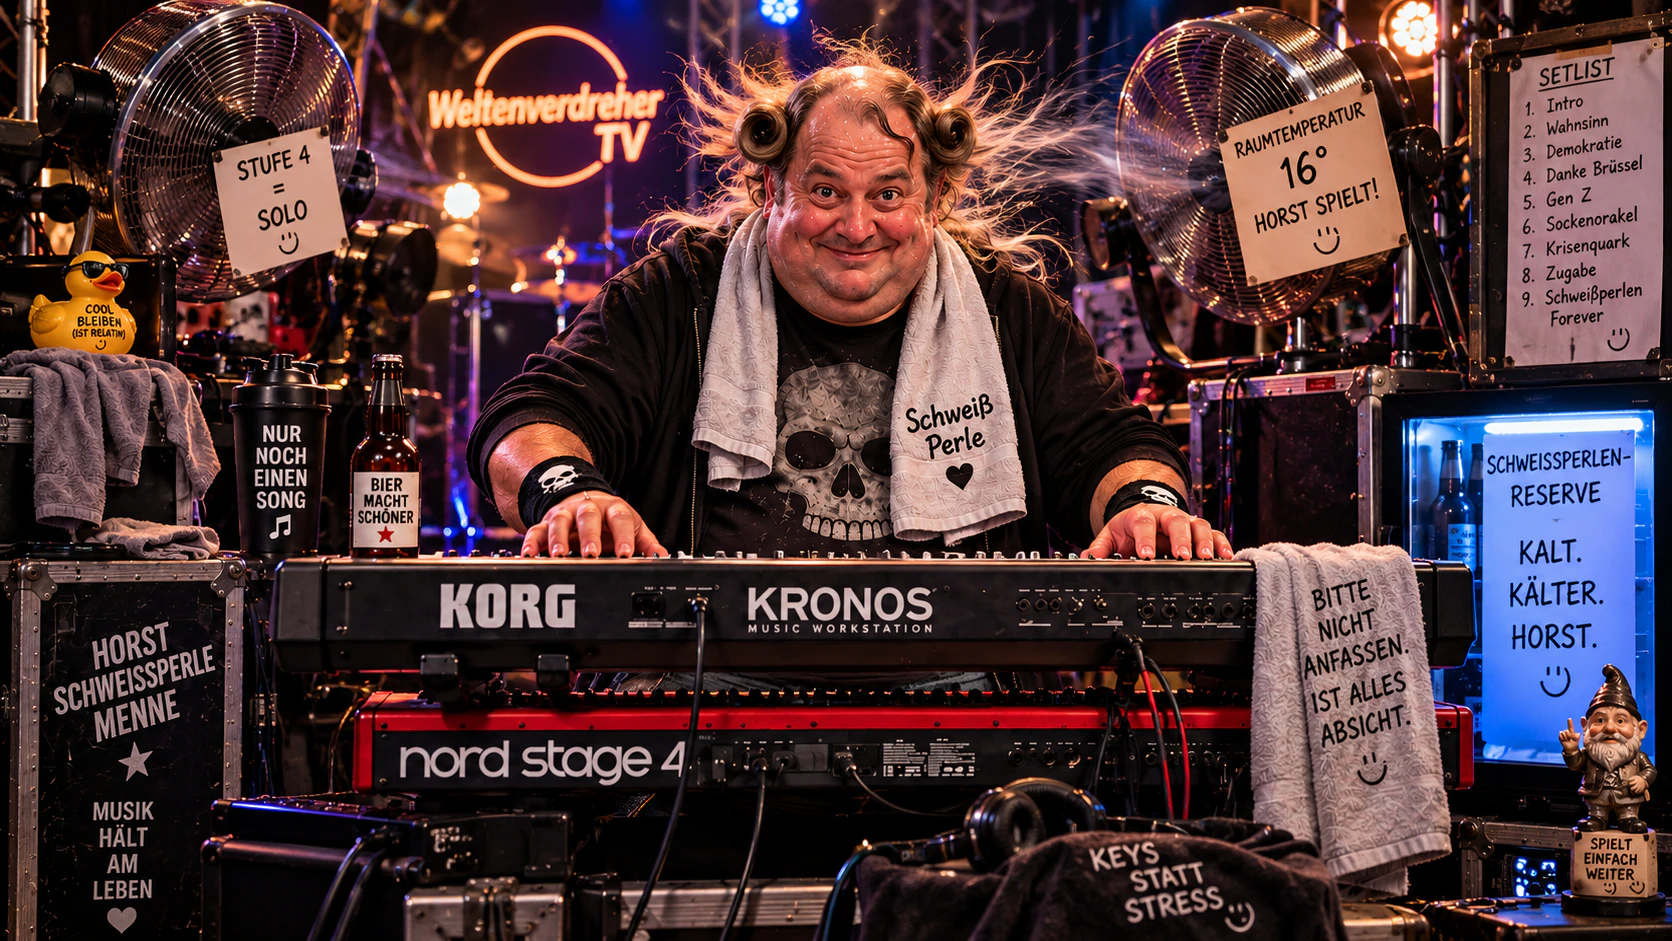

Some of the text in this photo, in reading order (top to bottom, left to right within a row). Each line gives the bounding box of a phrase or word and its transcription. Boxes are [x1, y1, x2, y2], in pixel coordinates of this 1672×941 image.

[1539, 56, 1616, 87] SETLIST
[428, 81, 665, 130] Weltenverdreher
[1525, 96, 1584, 117] 1. Intro
[1234, 101, 1365, 159] RAUMTEMPERATUR
[1523, 116, 1609, 139] 2. Wahnsinn
[593, 120, 651, 163] TV
[1523, 136, 1622, 163] 3. Demokratie
[237, 145, 310, 181] STUFE 4
[1280, 145, 1327, 189] 16°
[1523, 154, 1643, 186] 4. Danke Brüssel
[273, 183, 285, 194] =
[1523, 187, 1592, 210] 5. Gen Z
[258, 200, 307, 231] SOLO
[1254, 177, 1379, 234] HORST SPIELT!
[1522, 205, 1638, 235] 6. Sockenorakel
[1522, 232, 1630, 259] 7. Krisenquark
[1522, 262, 1597, 284] 8. Zugabe
[1521, 281, 1643, 308] 9. Schweißperlen
[77, 316, 122, 327] BLEIBEN
[85, 304, 114, 315] COOL
[1551, 310, 1605, 327] Forever
[72, 329, 89, 339] (IST
[906, 393, 994, 433] Schweiß
[262, 425, 302, 443] NUR
[925, 426, 986, 460] Perle
[256, 447, 307, 465] NOCH
[1487, 447, 1631, 475] SCHWEISSPERLEN-
[254, 469, 308, 487] EINEN
[371, 477, 403, 492] BIER
[256, 491, 306, 510] SONG
[363, 494, 409, 508] MACHT
[1511, 481, 1601, 508] RESERVE
[357, 508, 414, 524] SCHÖNER
[1519, 539, 1582, 565] KALT.
[748, 586, 933, 621] KRONOS
[1311, 578, 1371, 612] BITTE
[1510, 576, 1604, 607] KÄLTER.
[440, 583, 576, 628] KORG
[748, 624, 933, 633] MUSIC WORKSTATION
[1318, 608, 1375, 642] NICHT
[1512, 623, 1597, 650] HORST.
[92, 621, 169, 671] HORST
[1304, 633, 1409, 680] ANFASSEN.
[53, 644, 216, 716] SCHWEISSPERLE
[1311, 671, 1406, 714] IST ALLES
[93, 689, 181, 743] MENNE
[1321, 704, 1411, 748] ABSICHT.
[400, 740, 686, 786] nord stage 4
[92, 801, 155, 821] MUSIK
[99, 824, 149, 848] HÄLT
[1590, 837, 1633, 851] SPIELT
[106, 853, 138, 874] AM
[1089, 841, 1160, 872] KEYS
[1584, 852, 1638, 866] EINFACH
[1130, 861, 1203, 893] STATT
[1586, 868, 1635, 881] WEITER
[93, 879, 153, 900] LEBEN
[1124, 885, 1224, 924] STRESS
